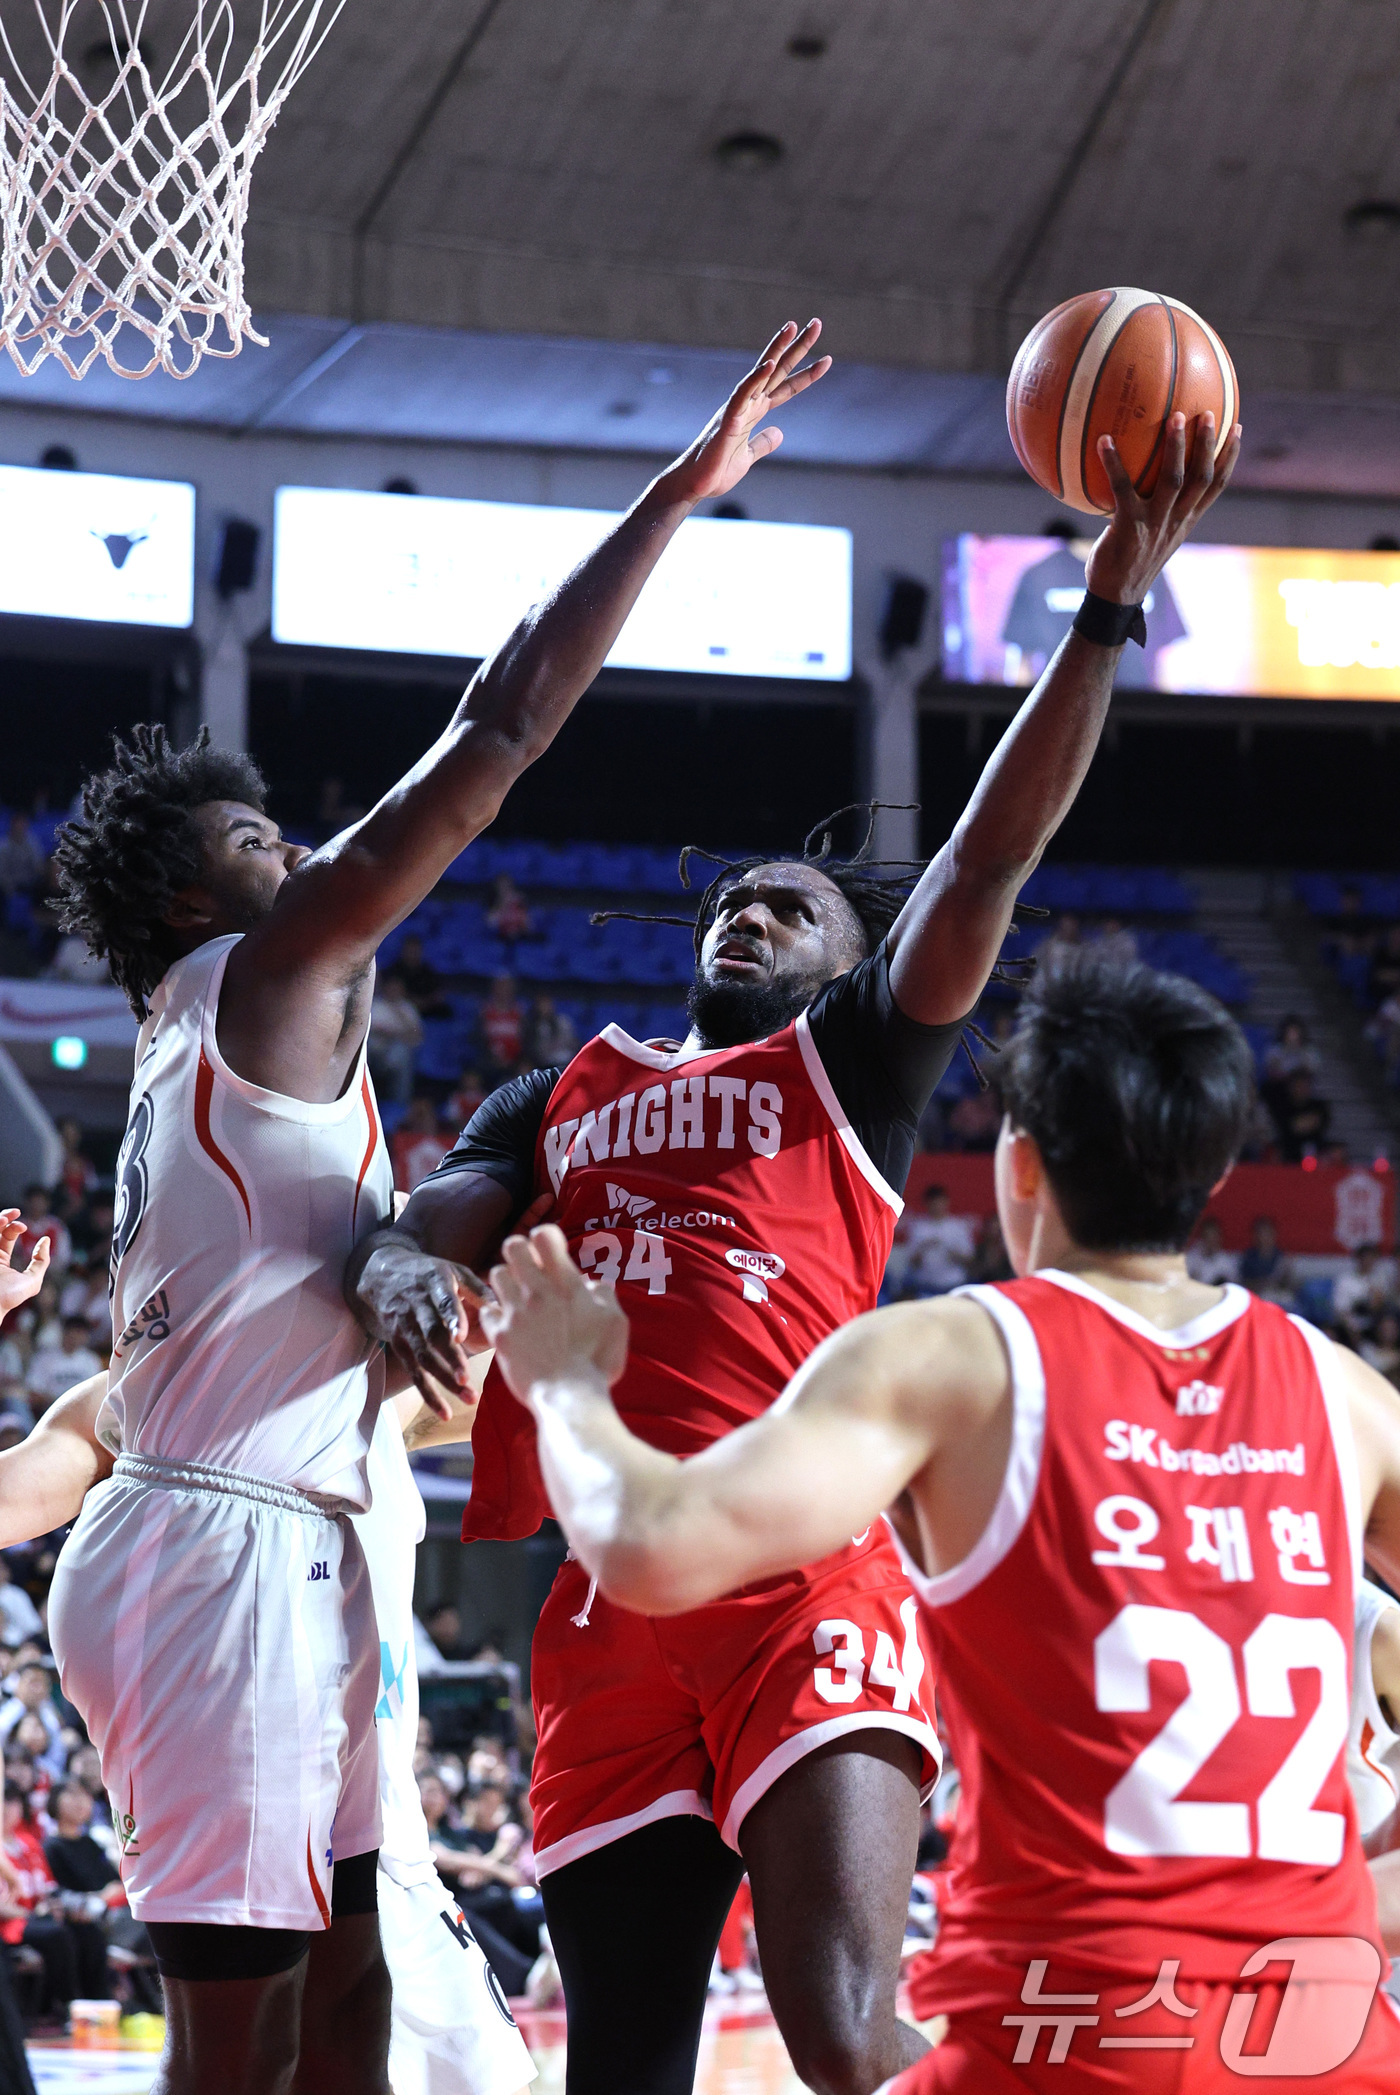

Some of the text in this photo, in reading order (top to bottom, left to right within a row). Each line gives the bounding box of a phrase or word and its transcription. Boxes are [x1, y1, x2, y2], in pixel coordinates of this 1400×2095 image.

[543, 1076, 783, 1199] KNIGHTS
[578, 1231, 673, 1295] 34
[635, 1211, 736, 1231] telecom
[733, 1253, 778, 1275] 에이닷
[813, 1596, 925, 1712] 34
[1093, 1603, 1348, 1867] 22
